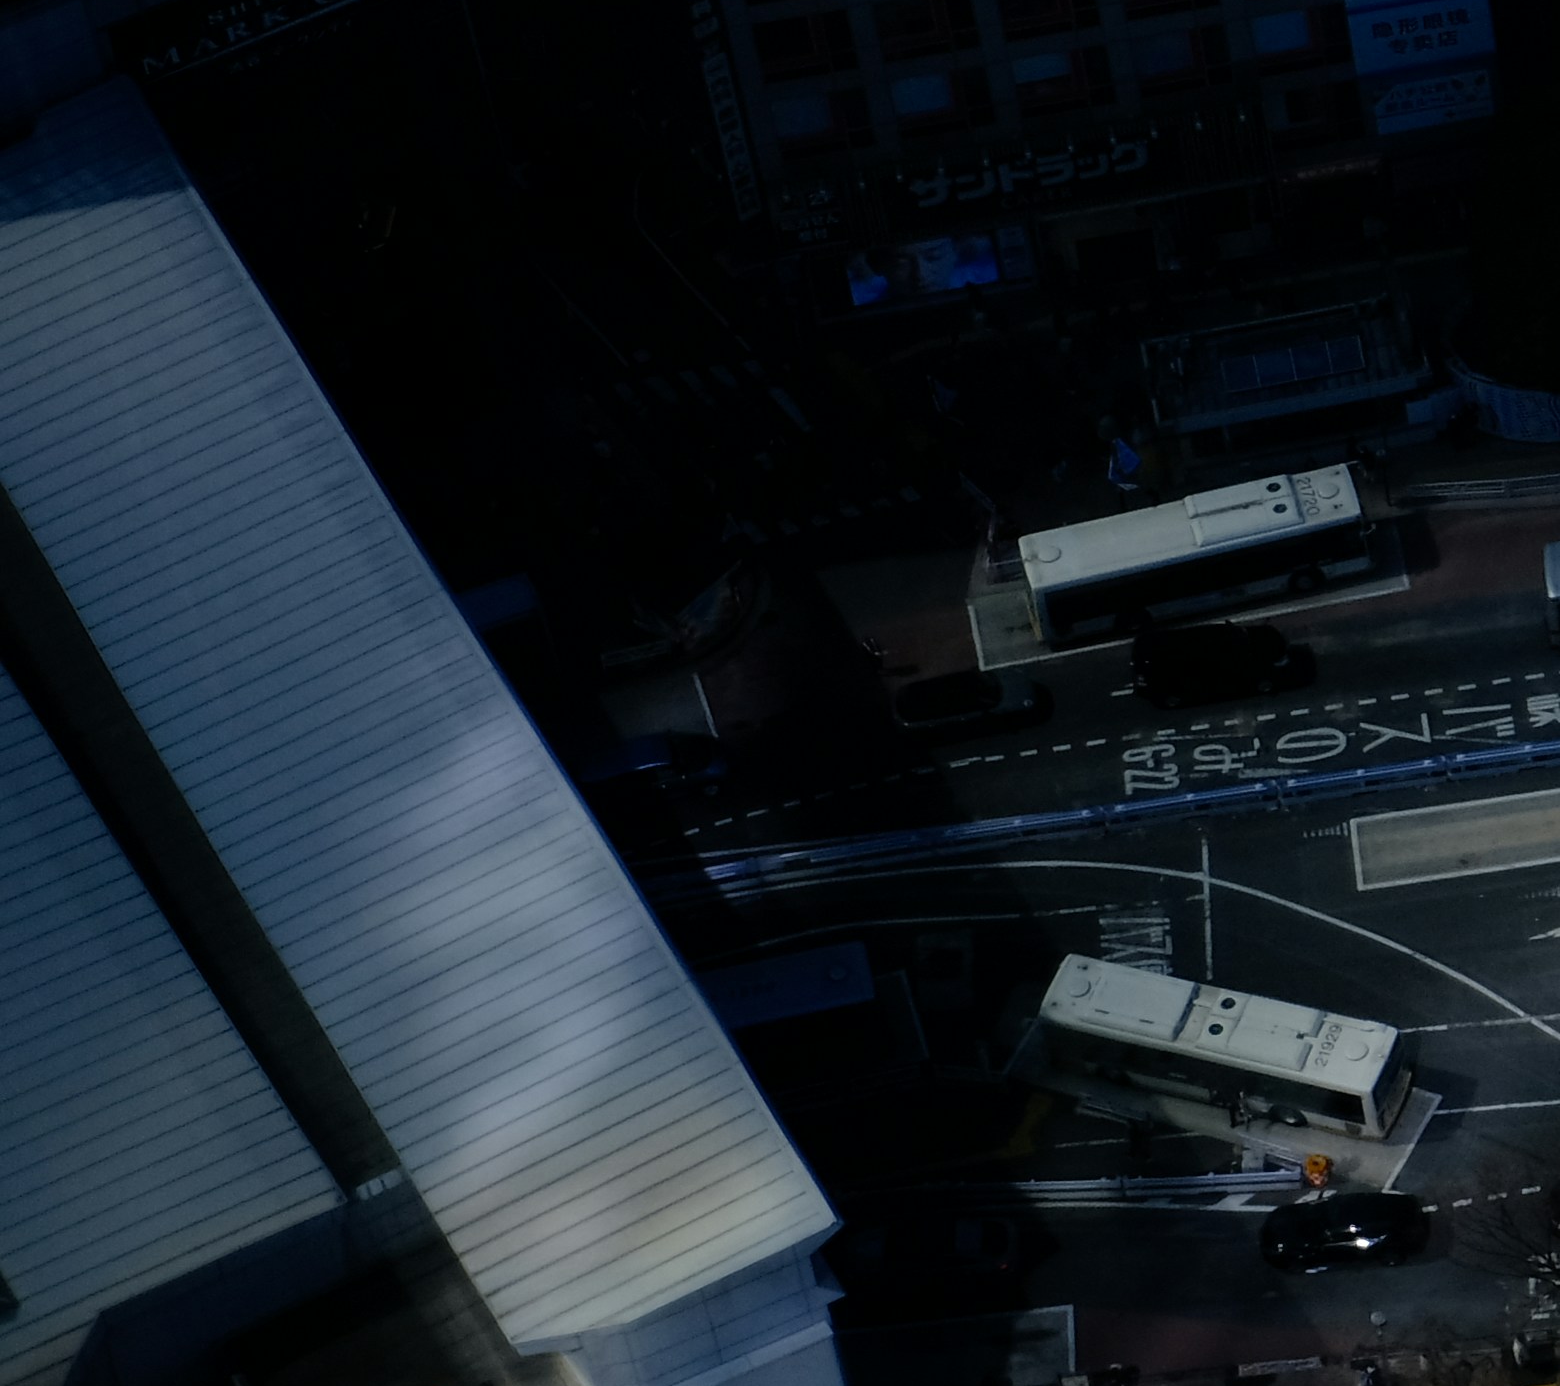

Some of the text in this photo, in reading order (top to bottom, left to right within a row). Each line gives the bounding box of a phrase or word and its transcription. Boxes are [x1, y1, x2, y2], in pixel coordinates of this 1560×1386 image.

[141, 9, 289, 76] MARK
[910, 138, 1150, 209] サンドラッグ
[1314, 1023, 1343, 1068] 21929
